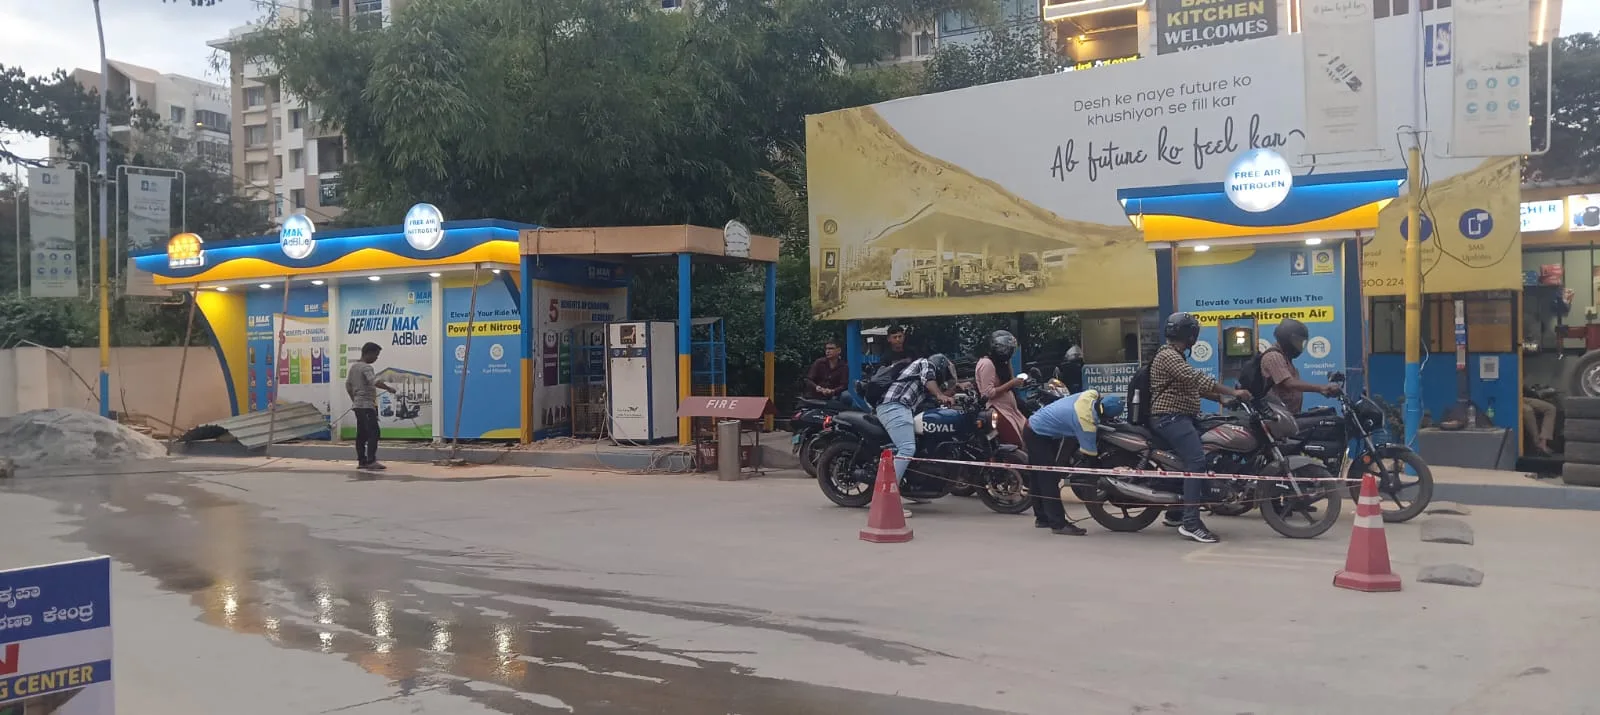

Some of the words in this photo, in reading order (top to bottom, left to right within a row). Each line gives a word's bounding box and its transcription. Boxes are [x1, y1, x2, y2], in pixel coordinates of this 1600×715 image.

[1167, 1, 1265, 27] KITCHEN
[1164, 19, 1269, 45] WELCOMES
[1073, 96, 1111, 112] Desh
[1114, 93, 1132, 105] ke
[1136, 86, 1175, 104] naye
[1179, 78, 1229, 96] future
[1232, 74, 1252, 88] ko
[1087, 104, 1164, 126] khushiyon
[1168, 101, 1187, 114] se
[1191, 97, 1209, 111] fill
[1212, 94, 1237, 108] kar
[1050, 138, 1080, 182] Ab
[1087, 141, 1148, 182] future
[1157, 125, 1184, 165] ko
[1192, 116, 1239, 170] feel
[1234, 171, 1261, 180] FREE
[1264, 169, 1281, 177] AIR
[1231, 180, 1285, 192] NITROGEN
[282, 228, 303, 237] MAK
[282, 237, 310, 247] AdBlue
[1386, 278, 1404, 287] 224
[1195, 299, 1230, 307] Elevate
[1232, 297, 1254, 305] Your
[1256, 296, 1278, 304] Ride
[1280, 295, 1302, 303] With
[1304, 294, 1324, 302] The
[549, 298, 559, 322] 5
[1193, 313, 1231, 323] Power
[1251, 309, 1305, 320] Nitrogen
[1308, 308, 1328, 319] Air
[348, 316, 390, 335] DEFINITELY
[391, 315, 421, 331] MAK
[478, 323, 487, 332] of
[490, 322, 520, 333] Nitrog
[391, 332, 428, 346] AdBlue
[1085, 367, 1101, 375] ALL
[1103, 366, 1137, 375] VEHICL
[1087, 375, 1134, 384] INSURAN
[1115, 384, 1129, 392] HE
[705, 399, 739, 410] FIRE
[922, 421, 956, 433] ROYAL
[43, 601, 94, 623] ಕೇಂದ್ರ
[14, 665, 94, 696] CENTER
